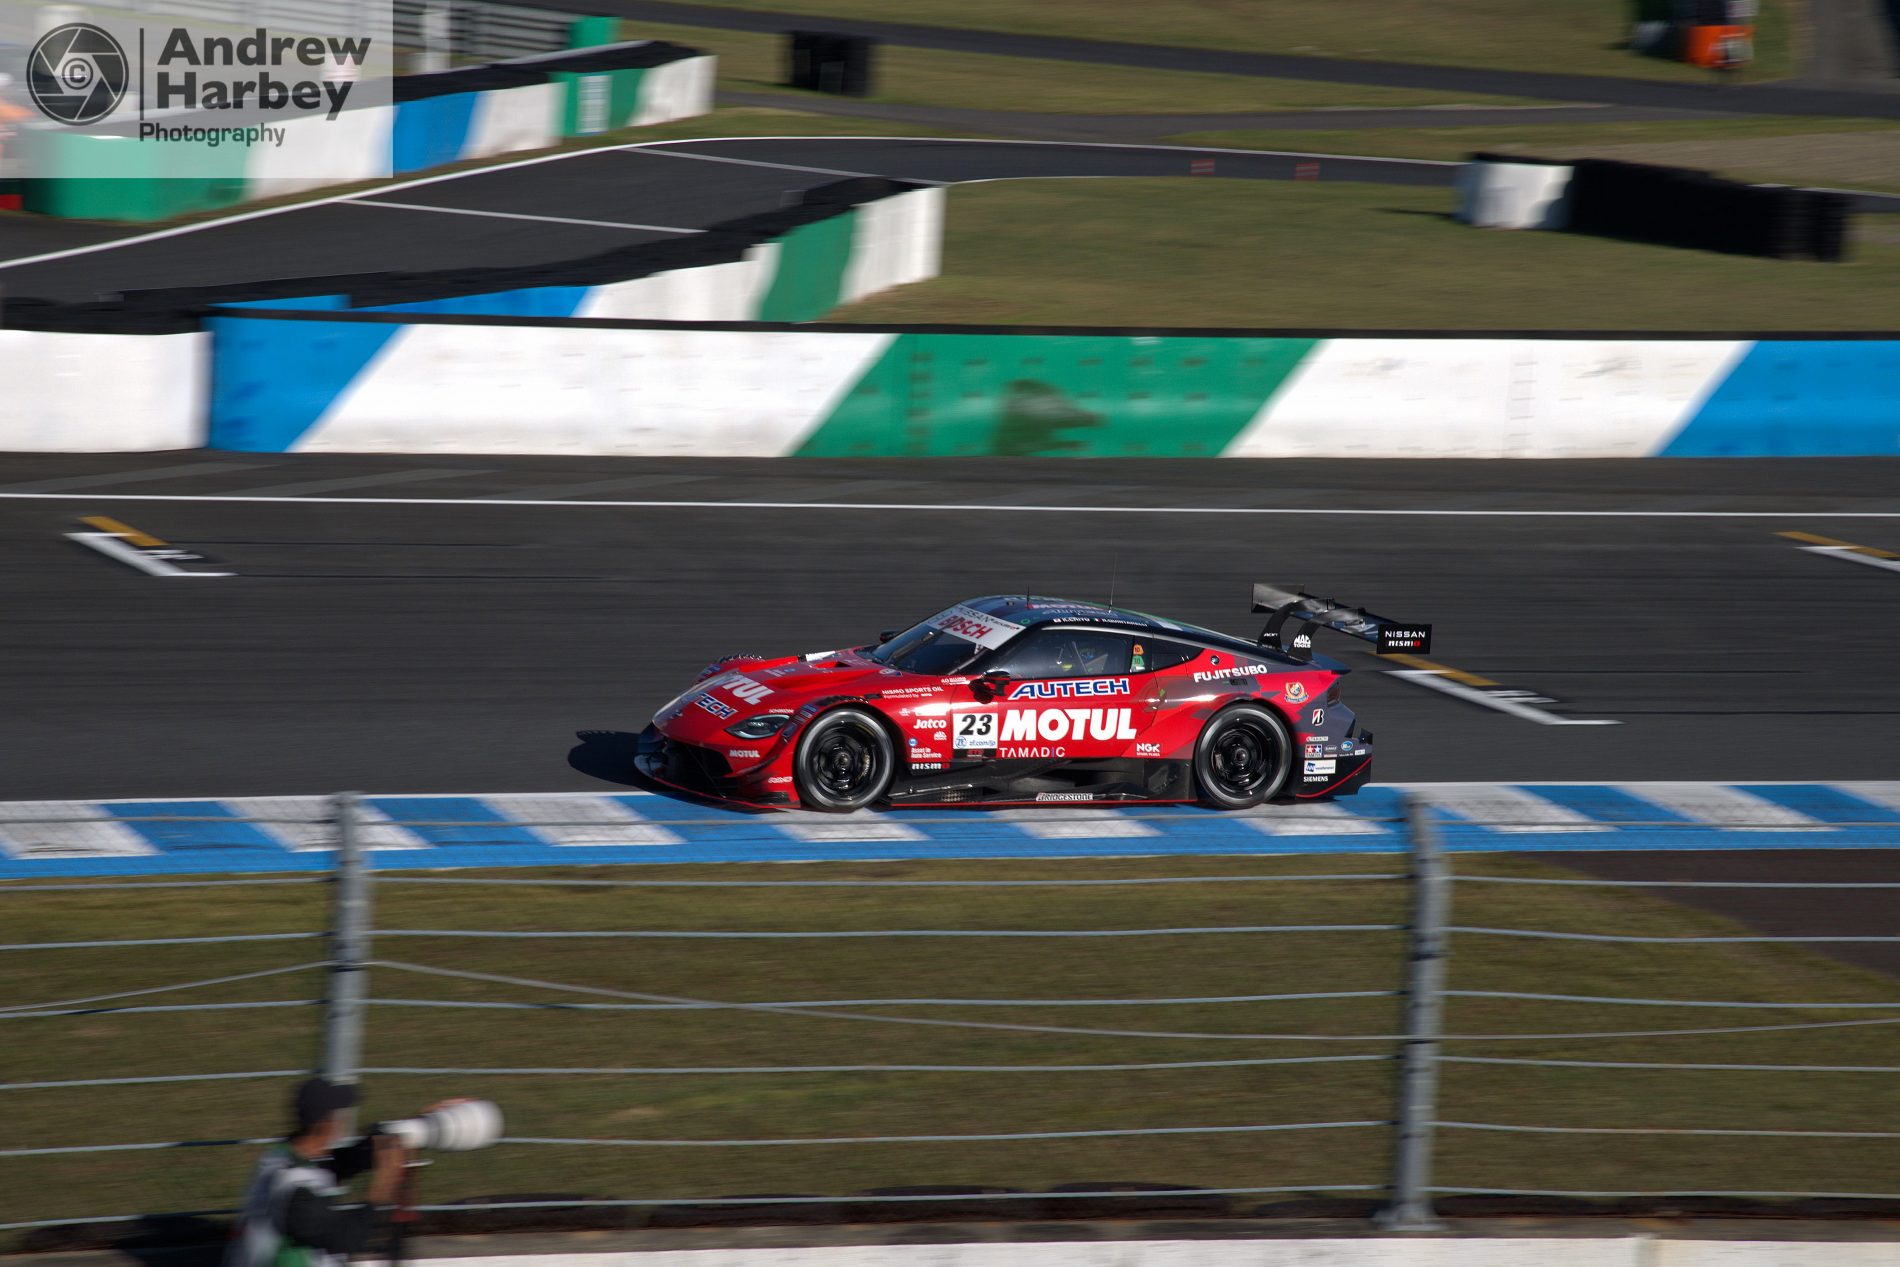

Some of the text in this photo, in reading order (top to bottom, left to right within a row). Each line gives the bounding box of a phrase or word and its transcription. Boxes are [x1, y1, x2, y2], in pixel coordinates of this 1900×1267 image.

[1194, 664, 1267, 683] FUJITSUBO
[720, 673, 775, 706] TUL
[1008, 678, 1131, 700] AUTECH
[913, 719, 947, 729] Jatco
[960, 714, 992, 736] 23
[1000, 708, 1137, 741] MOTUL
[729, 750, 760, 758] MOTUL
[1000, 747, 1065, 758] TAMADIC
[1136, 743, 1160, 753] NGK
